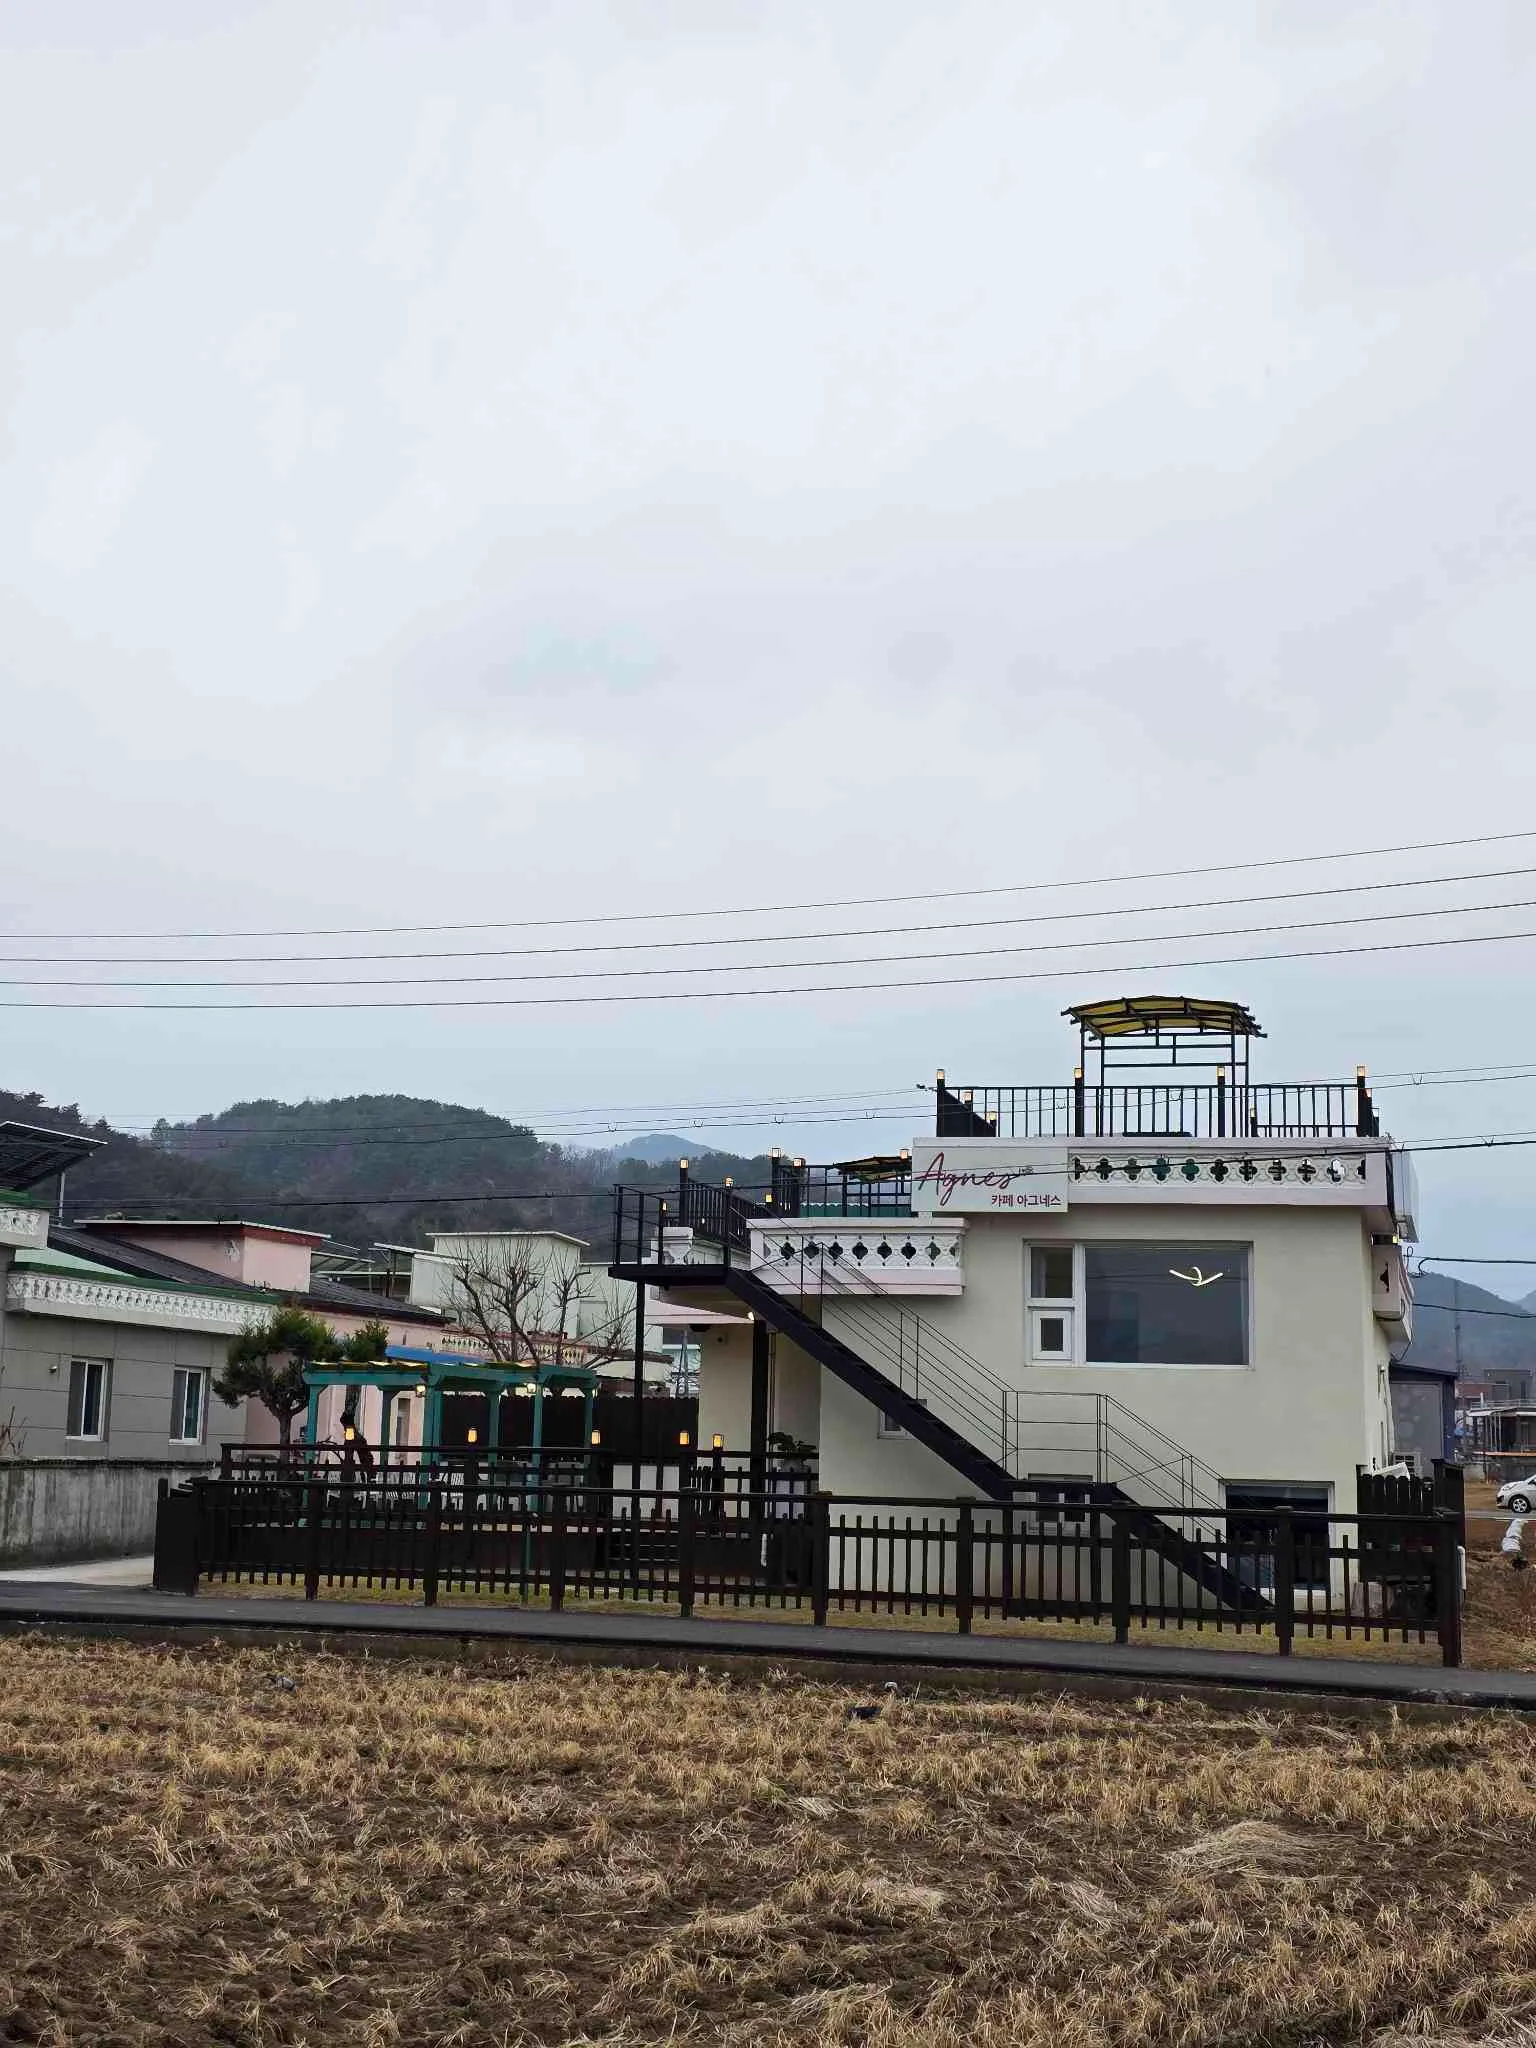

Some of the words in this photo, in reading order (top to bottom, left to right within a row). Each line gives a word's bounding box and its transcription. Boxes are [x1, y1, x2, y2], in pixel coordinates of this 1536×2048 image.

[914, 1152, 1018, 1206] Agnes
[991, 1194, 1013, 1207] 카페
[1017, 1194, 1061, 1207] 아그네스
